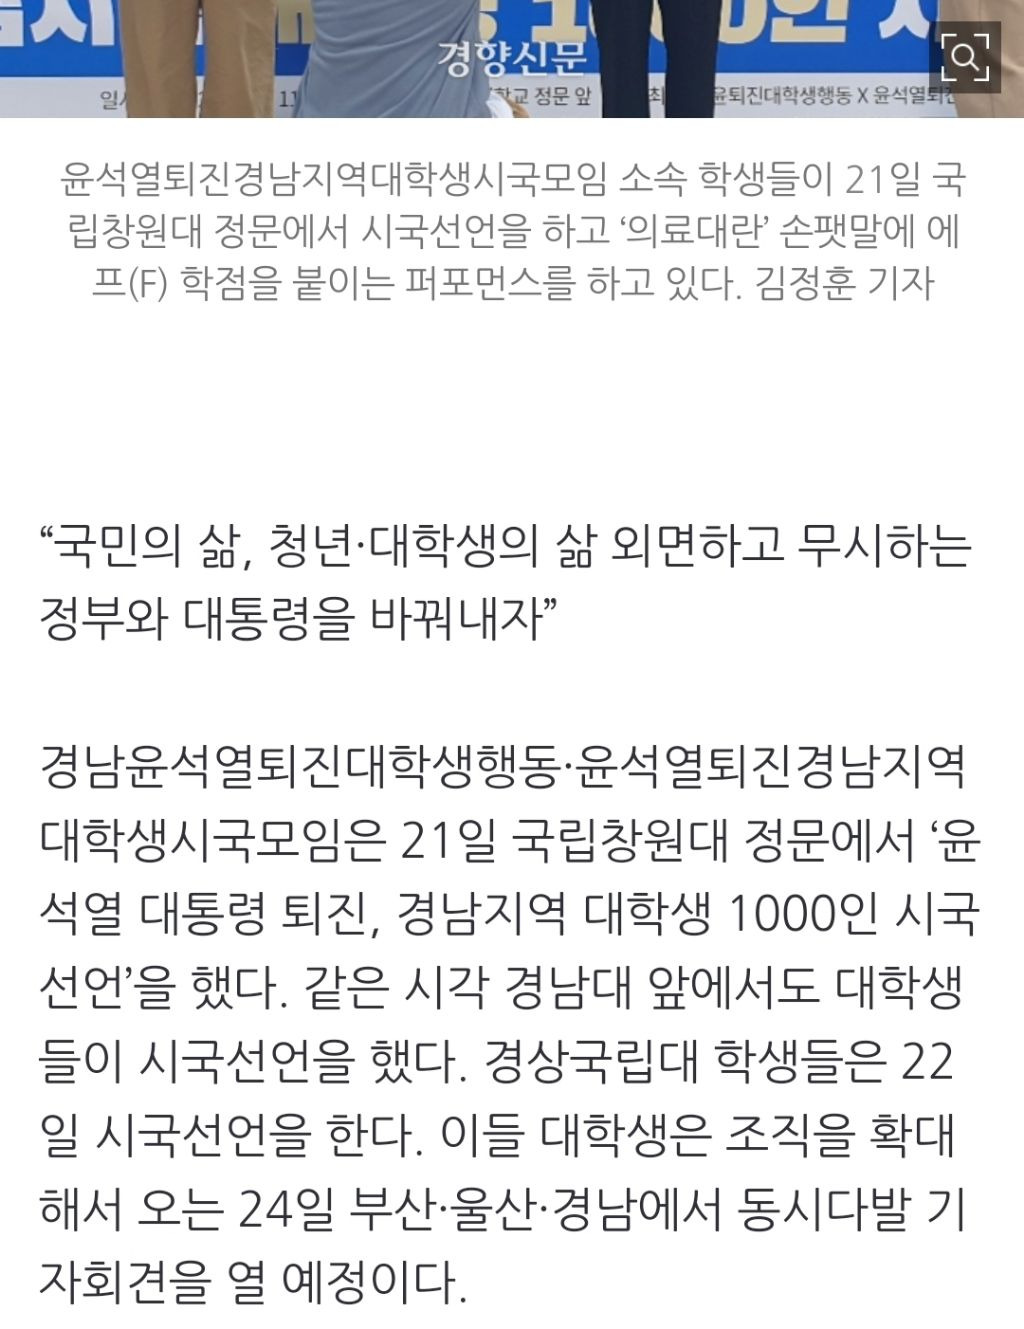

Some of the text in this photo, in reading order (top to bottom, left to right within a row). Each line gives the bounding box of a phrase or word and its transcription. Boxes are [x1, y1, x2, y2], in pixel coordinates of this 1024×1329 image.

[534, 86, 570, 106] 정문
[574, 86, 592, 106] 앞
[856, 88, 869, 104] X
[61, 162, 966, 197] 윤석열퇴진경남지역대학생시국모임 소속 학생들이 21일 국
[70, 214, 957, 249] 립창원대 정문에서 시국선언을 하고 ‘의료대란’ 손팻말에 에
[93, 266, 935, 302] 프(F) 학점을 붙이는 퍼포먼스를 하고 있다. 김정훈 기자
[41, 524, 971, 571] “국민의 삶, 청년·대학생의 삶 외면하고 무시하는
[41, 597, 556, 641] 정부와 대통령을 바꿔내자”
[42, 745, 963, 789] 경남윤석열퇴진대학생행동·윤석열퇴진경남지역
[42, 819, 981, 864] 대학생시국모임은 21일 국립창원대 정문에서 ‘윤
[40, 892, 980, 939] 석열 대통령 퇴진, 경남지역 대학생 1000인 시국
[40, 966, 960, 1010] 선언’을 했다. 같은 시각 경남대 앞에서도 대학생
[39, 1039, 952, 1084] 들이 시국선언을 했다. 경상국립대 학생들은 22
[42, 1113, 952, 1158] 일 시국선언을 한다. 이들 대학생은 조직을 확대
[39, 1187, 963, 1232] 해서 오는 24일 부산·울산·경남에서 동시다발 기
[40, 1260, 466, 1305] 자회견을 열 예정이다.
